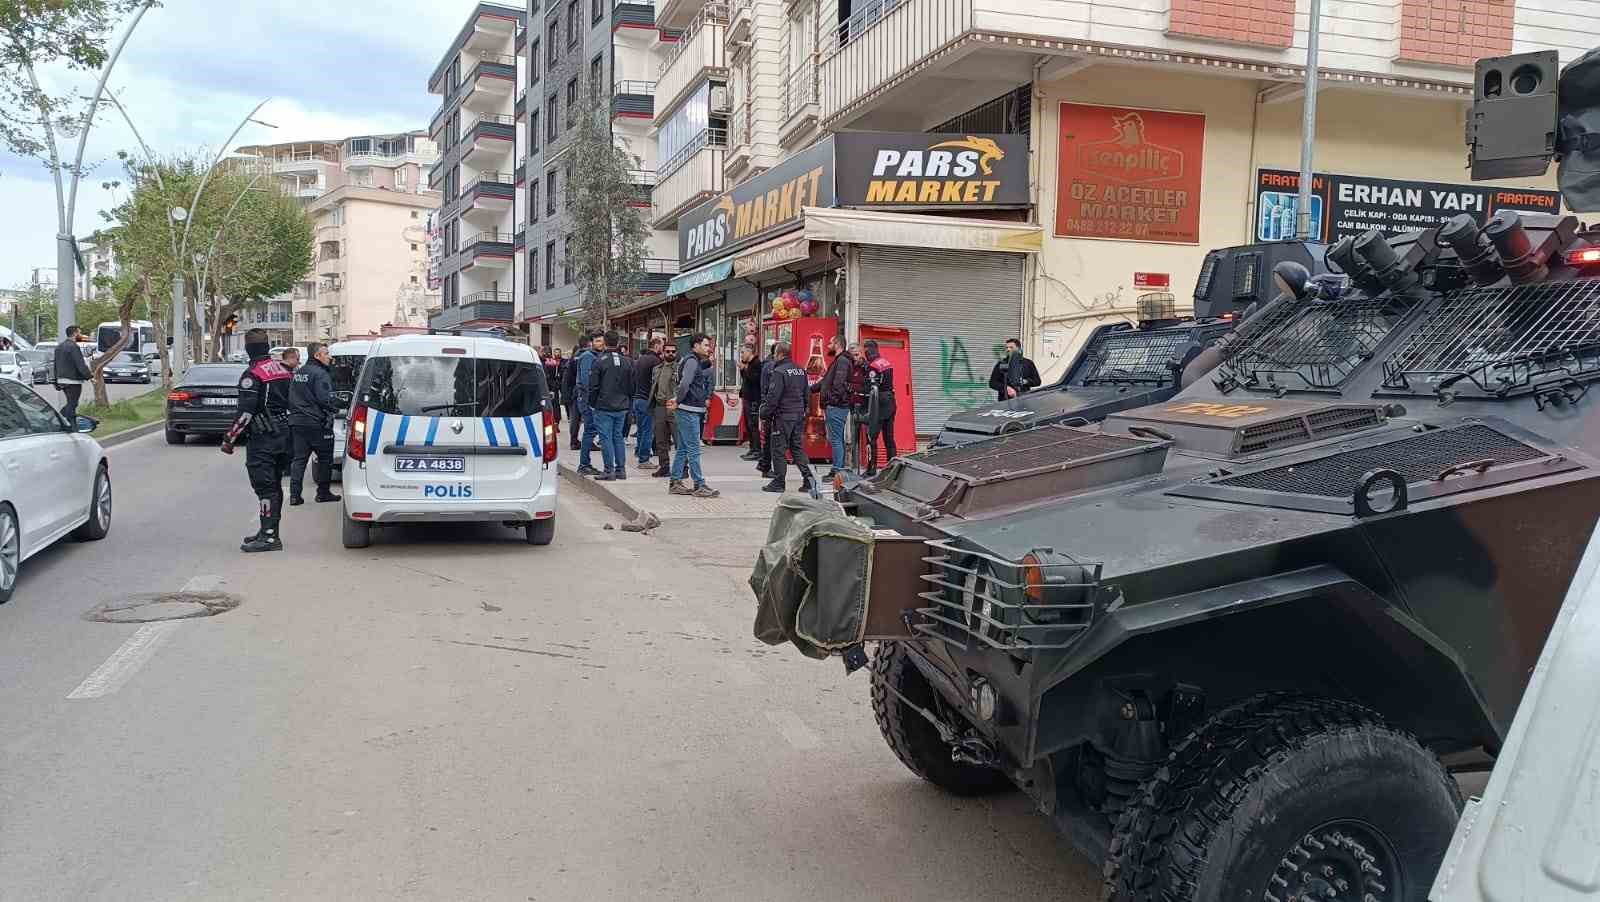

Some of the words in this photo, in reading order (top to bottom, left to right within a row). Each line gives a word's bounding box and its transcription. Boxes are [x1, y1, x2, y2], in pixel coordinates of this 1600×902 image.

[872, 150, 980, 177] PARS
[1261, 173, 1323, 189] FIRATN
[866, 180, 1001, 202] MARKET
[1338, 183, 1422, 207] ERHAN
[1430, 190, 1483, 211] YAPI
[1497, 192, 1554, 208] FIRATPEN
[686, 213, 726, 259] PARS
[734, 166, 825, 240] MARKET
[1081, 203, 1179, 224] MARKET
[1344, 209, 1367, 218] ÇELİK
[1368, 211, 1386, 219] KAPI
[1392, 213, 1407, 221] ODA
[1409, 214, 1434, 223] KAPISI
[1337, 221, 1354, 229] CAM
[1355, 222, 1387, 231] BALKON
[398, 459, 414, 469] 72
[418, 459, 427, 469] A
[430, 459, 462, 469] 4838
[425, 482, 472, 497] POLİS
